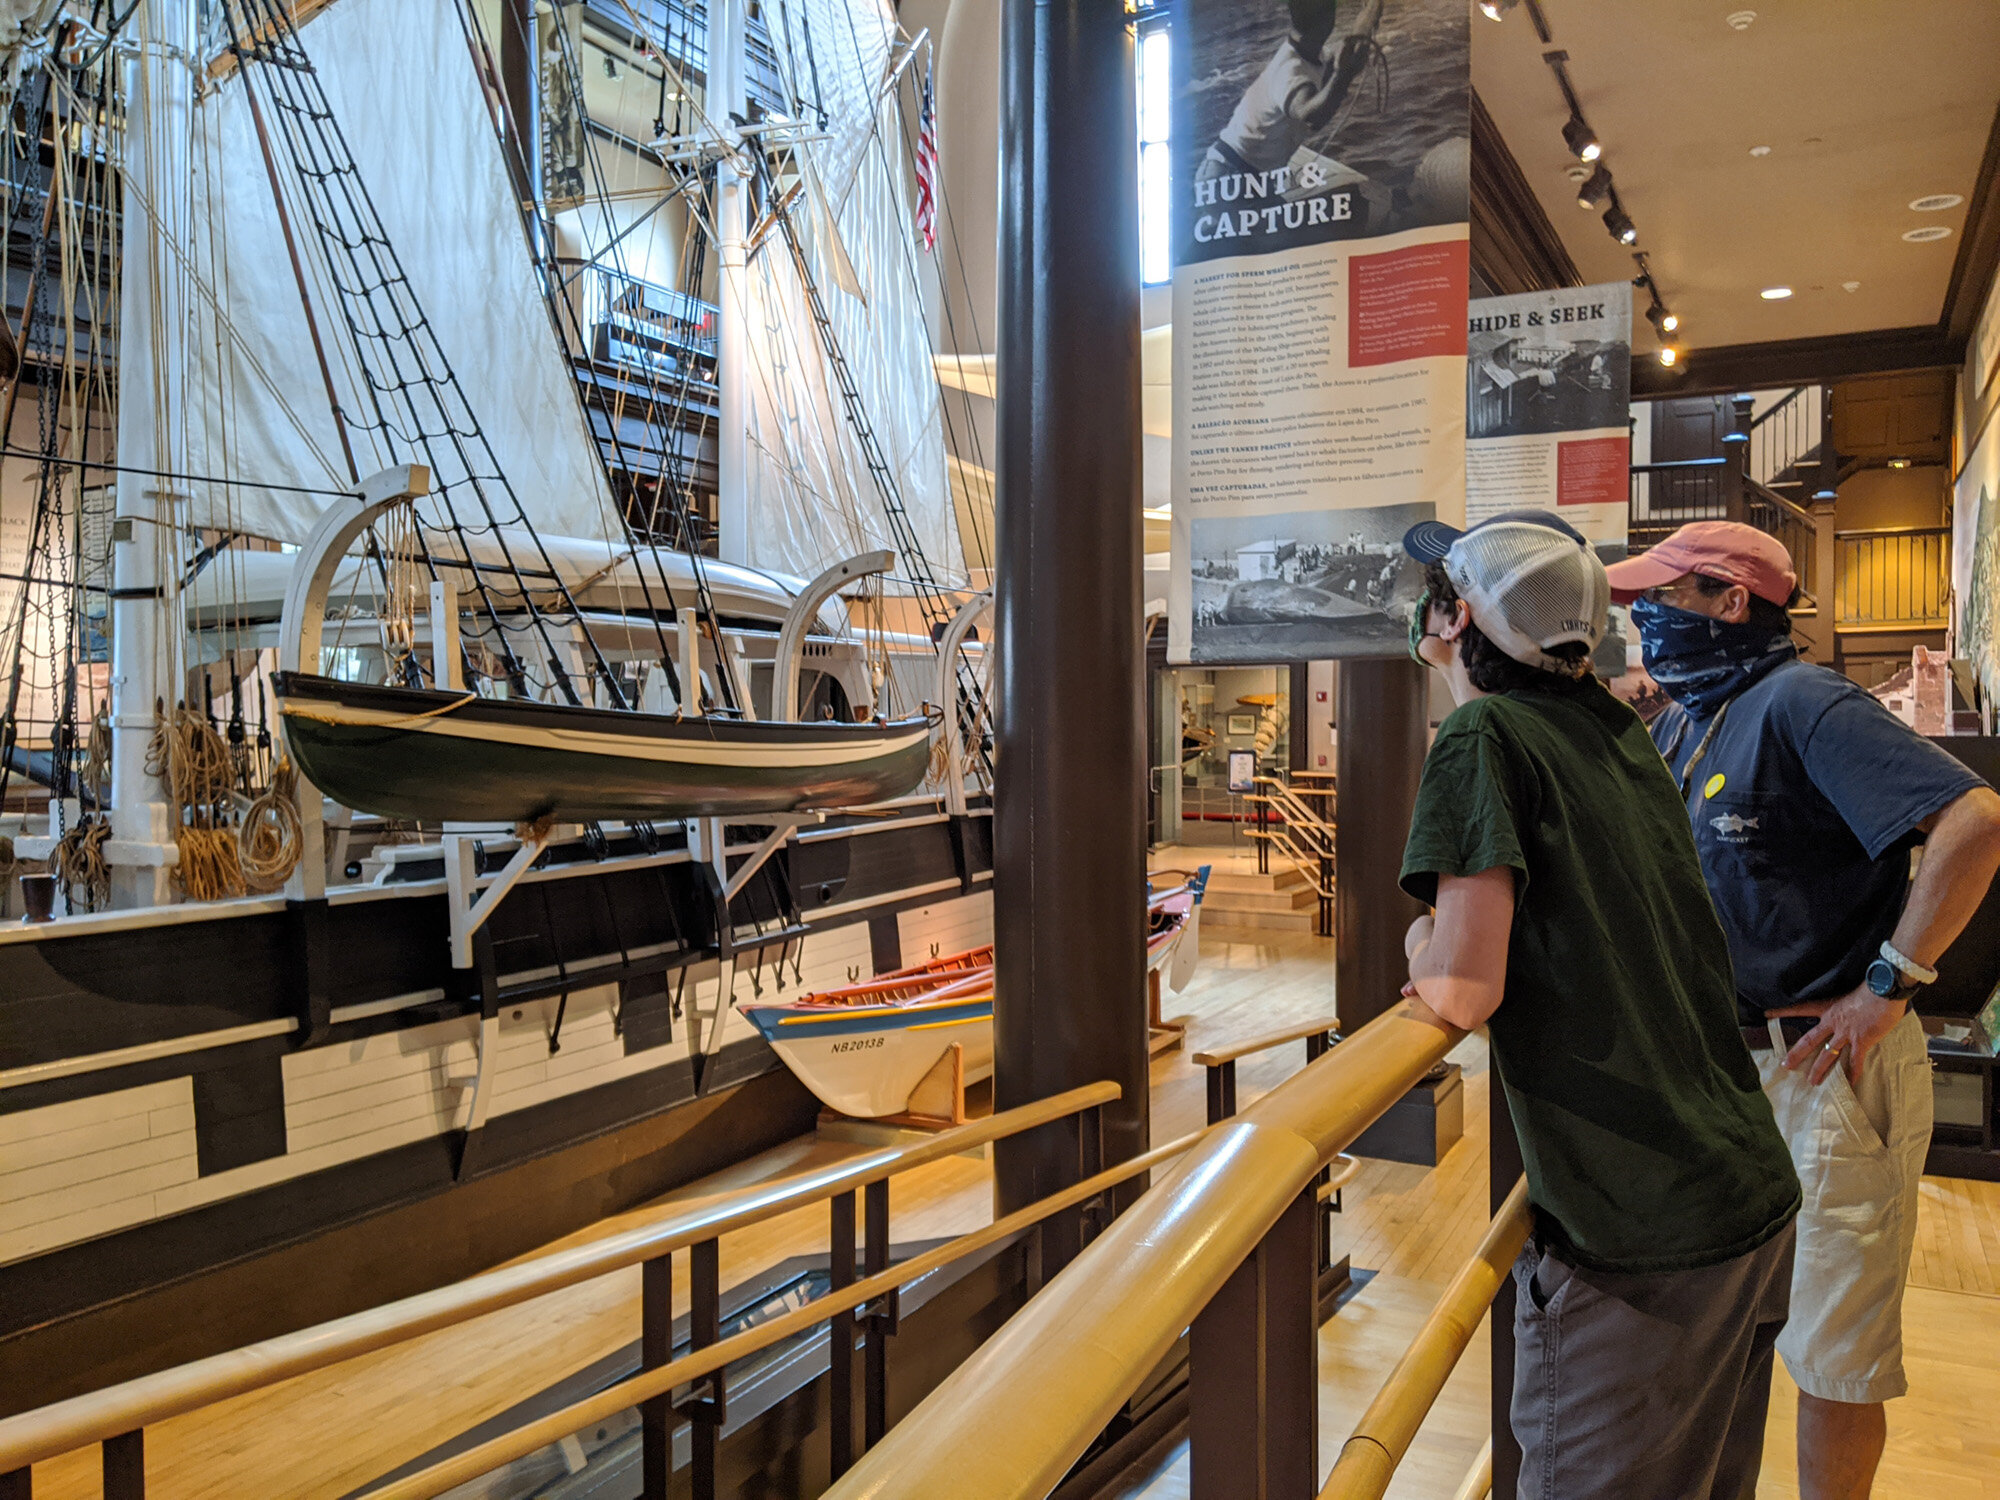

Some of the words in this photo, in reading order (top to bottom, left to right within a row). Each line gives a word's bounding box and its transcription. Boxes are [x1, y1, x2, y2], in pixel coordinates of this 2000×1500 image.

[1194, 167, 1292, 207] HUNT
[1300, 161, 1327, 189] &
[1193, 193, 1351, 242] CAPTURE
[1469, 313, 1520, 333] HIDE
[1527, 311, 1544, 326] &
[1550, 304, 1604, 324] SEEK
[831, 1037, 884, 1054] NB2013B
